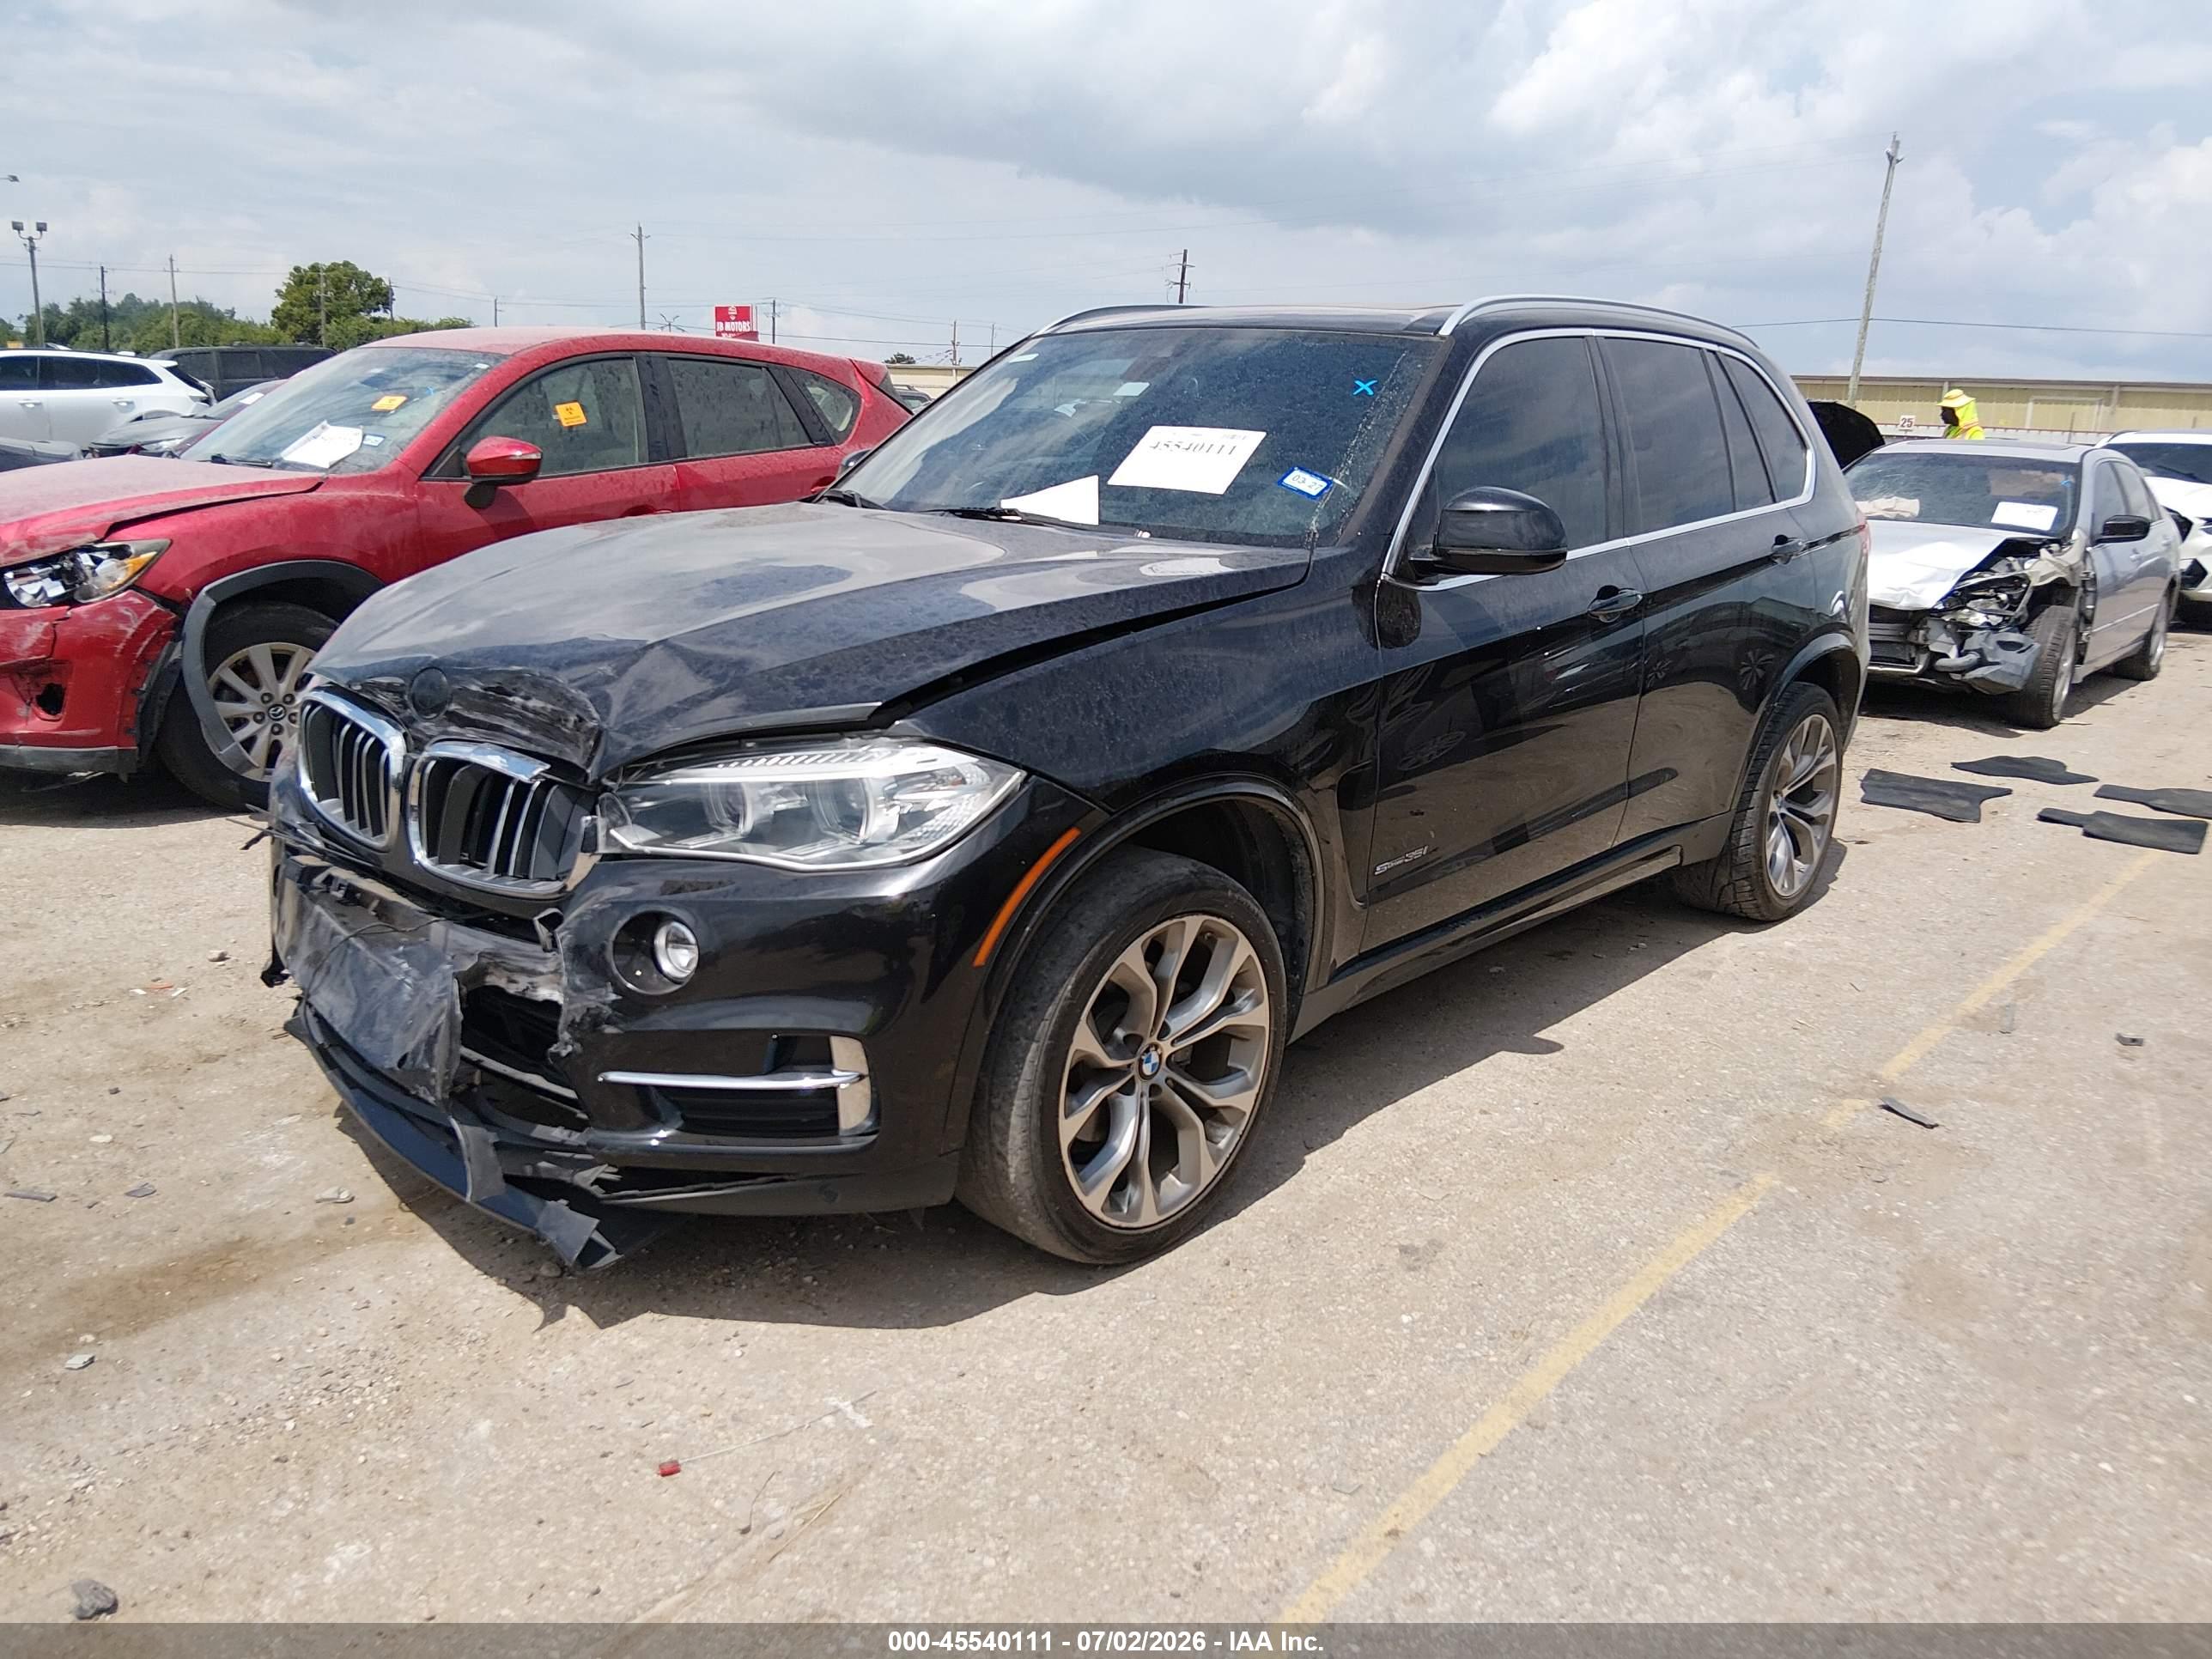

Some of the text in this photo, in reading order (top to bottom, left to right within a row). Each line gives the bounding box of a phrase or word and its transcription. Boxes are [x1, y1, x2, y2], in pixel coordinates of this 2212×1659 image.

[725, 321, 750, 332] MOTORS
[1900, 417, 1914, 428] 25
[1149, 441, 1237, 455] 45540111
